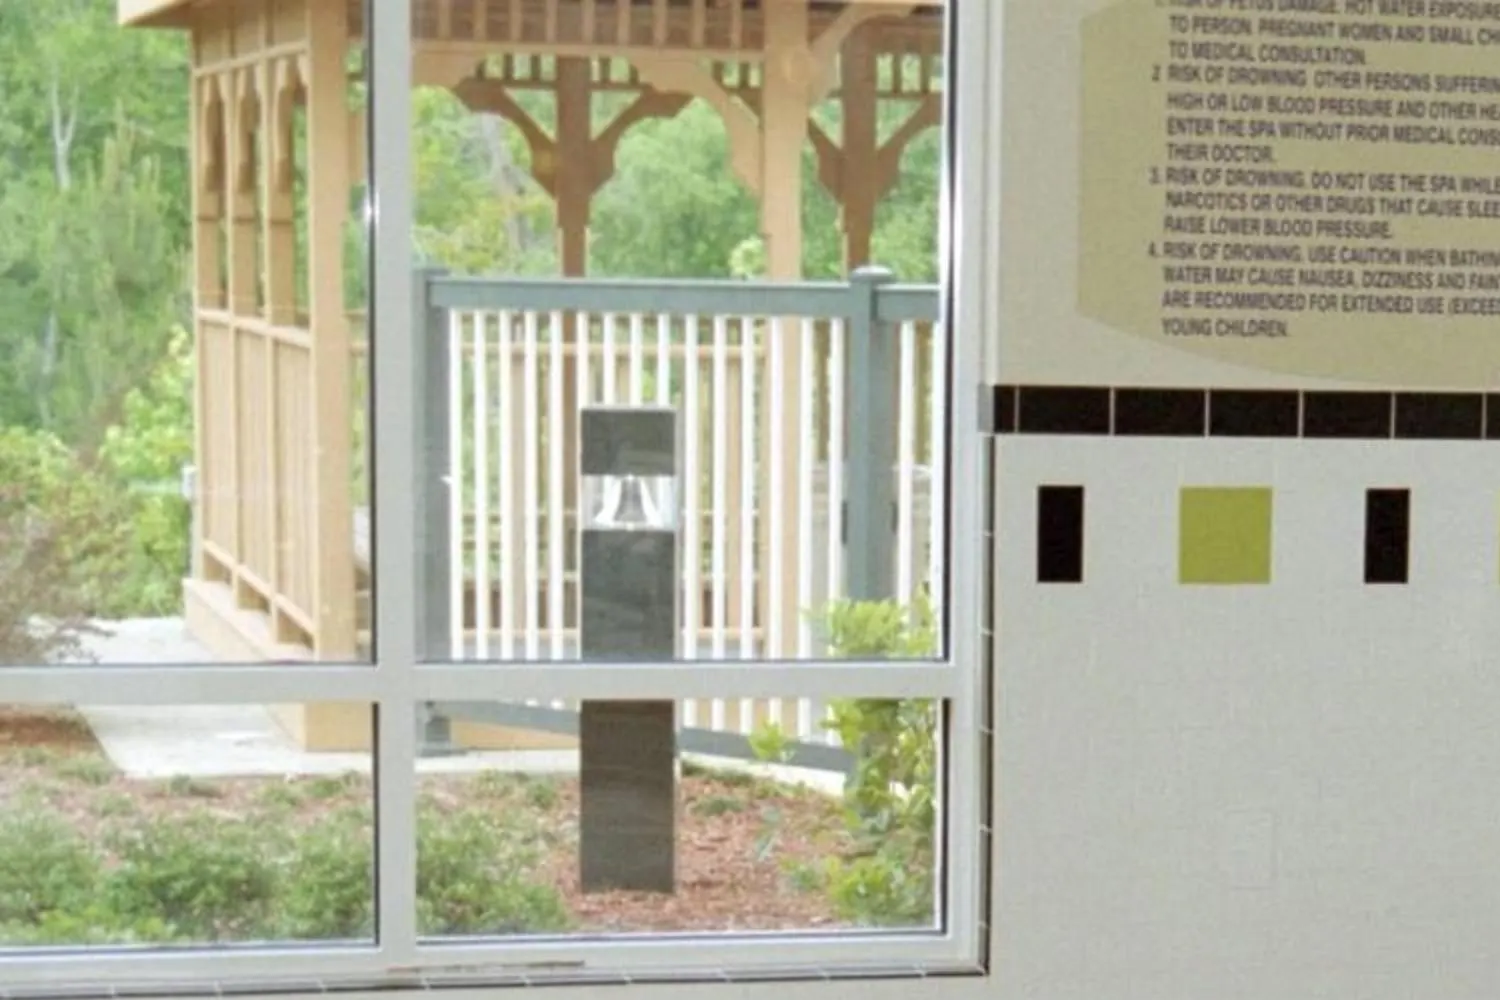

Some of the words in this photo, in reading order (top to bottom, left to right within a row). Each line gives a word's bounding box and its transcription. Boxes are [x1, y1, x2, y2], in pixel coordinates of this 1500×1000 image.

[1345, 0, 1372, 15] HOT
[1379, 1, 1425, 18] WATER
[1170, 15, 1188, 32] TO
[1259, 19, 1334, 38] PREGNANT
[1339, 22, 1392, 41] WOMEN
[1396, 24, 1425, 42] AND
[1430, 25, 1473, 44] SMALL
[1170, 40, 1188, 58] TO
[1192, 41, 1255, 61] MEDICAL
[1168, 65, 1201, 83] RISK
[1205, 66, 1224, 83] OF
[1314, 70, 1361, 89] OTHER
[1366, 72, 1430, 91] PERSONS
[1168, 92, 1203, 110] HIGH
[1208, 93, 1226, 111] OR
[1231, 94, 1262, 112] LOW
[1268, 96, 1315, 114] BLOOD
[1319, 97, 1392, 117] PRESSURE
[1396, 100, 1425, 118] AND
[1429, 101, 1476, 120] OTHER
[1168, 116, 1214, 136] ENTER
[1218, 117, 1244, 137] THE
[1249, 119, 1275, 138] SPA
[1279, 120, 1342, 140] WITHOUT
[1347, 122, 1389, 141] PRIOR
[1393, 124, 1454, 144] MEDICAL
[1167, 143, 1208, 161] THEIR
[1166, 167, 1198, 185] RISK
[1203, 168, 1222, 186] OF
[1312, 171, 1332, 190] DO
[1336, 172, 1364, 191] NOT
[1369, 173, 1395, 192] USE
[1400, 174, 1426, 193] THE
[1430, 175, 1457, 194] SPA
[1166, 192, 1247, 210] NARCOTICS
[1251, 194, 1271, 211] OR
[1276, 195, 1323, 212] OTHER
[1326, 197, 1375, 214] DRUGS
[1380, 198, 1412, 215] THAT
[1416, 199, 1463, 216] CAUSE
[1210, 217, 1260, 235] LOWER
[1264, 218, 1312, 236] BLOOD
[1163, 242, 1196, 257] RISK
[1199, 243, 1220, 258] OF
[1308, 246, 1336, 261] USE
[1340, 246, 1401, 263] CAUTION
[1405, 248, 1446, 264] WHEN
[1163, 266, 1211, 284] WATER
[1215, 267, 1244, 285] MAY
[1248, 268, 1295, 286] CAUSE
[1362, 270, 1433, 289] DIZZINESS
[1437, 272, 1465, 290] AND
[1163, 290, 1192, 307] ARE
[1195, 291, 1305, 310] RECOMMENDED
[1310, 293, 1337, 311] FOR
[1342, 294, 1413, 312] EXTENDED
[1418, 296, 1444, 313] USE
[1162, 317, 1211, 335] YOUNG
